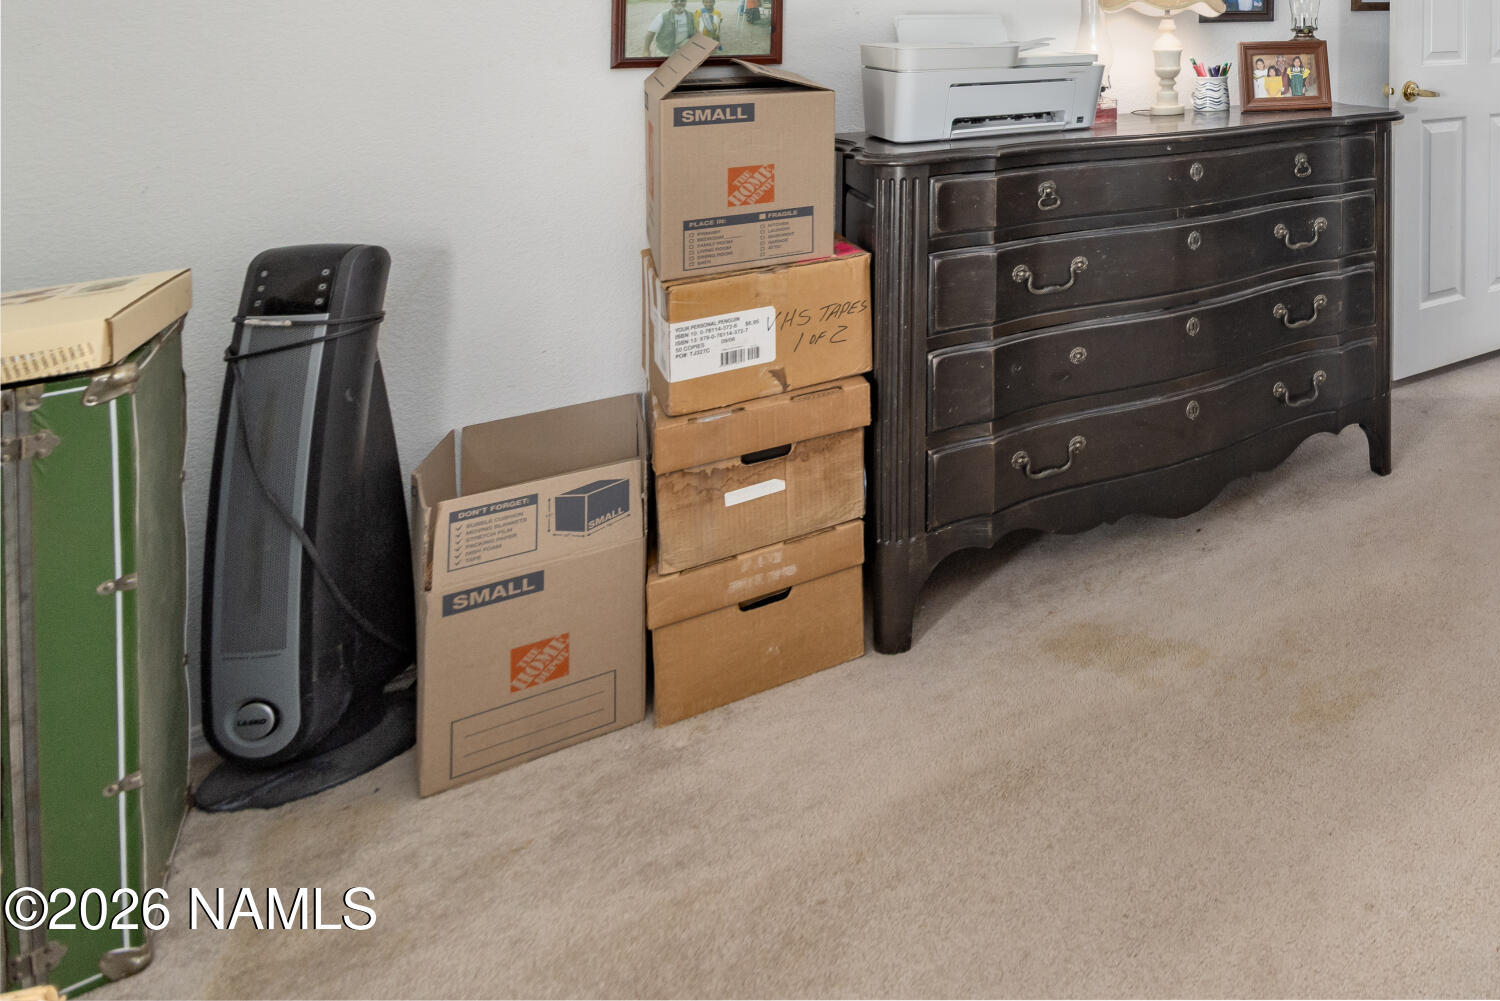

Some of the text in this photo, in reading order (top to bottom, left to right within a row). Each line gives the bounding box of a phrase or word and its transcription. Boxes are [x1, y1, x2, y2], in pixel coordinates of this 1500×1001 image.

[681, 107, 748, 123] SMALL
[728, 164, 775, 206] HOME
[732, 169, 753, 187] THE
[688, 219, 715, 228] PLACE
[767, 209, 798, 219] FRAGILE
[690, 321, 717, 330] PERSONAL
[766, 300, 868, 332] VHS TAPES
[683, 343, 705, 351] COPIES
[793, 332, 804, 353] 1
[829, 325, 848, 344] 2
[457, 498, 529, 519] DON'T FORGET:
[588, 506, 625, 530] SMALL
[452, 577, 536, 610] SMALL
[511, 637, 569, 689] HOME
